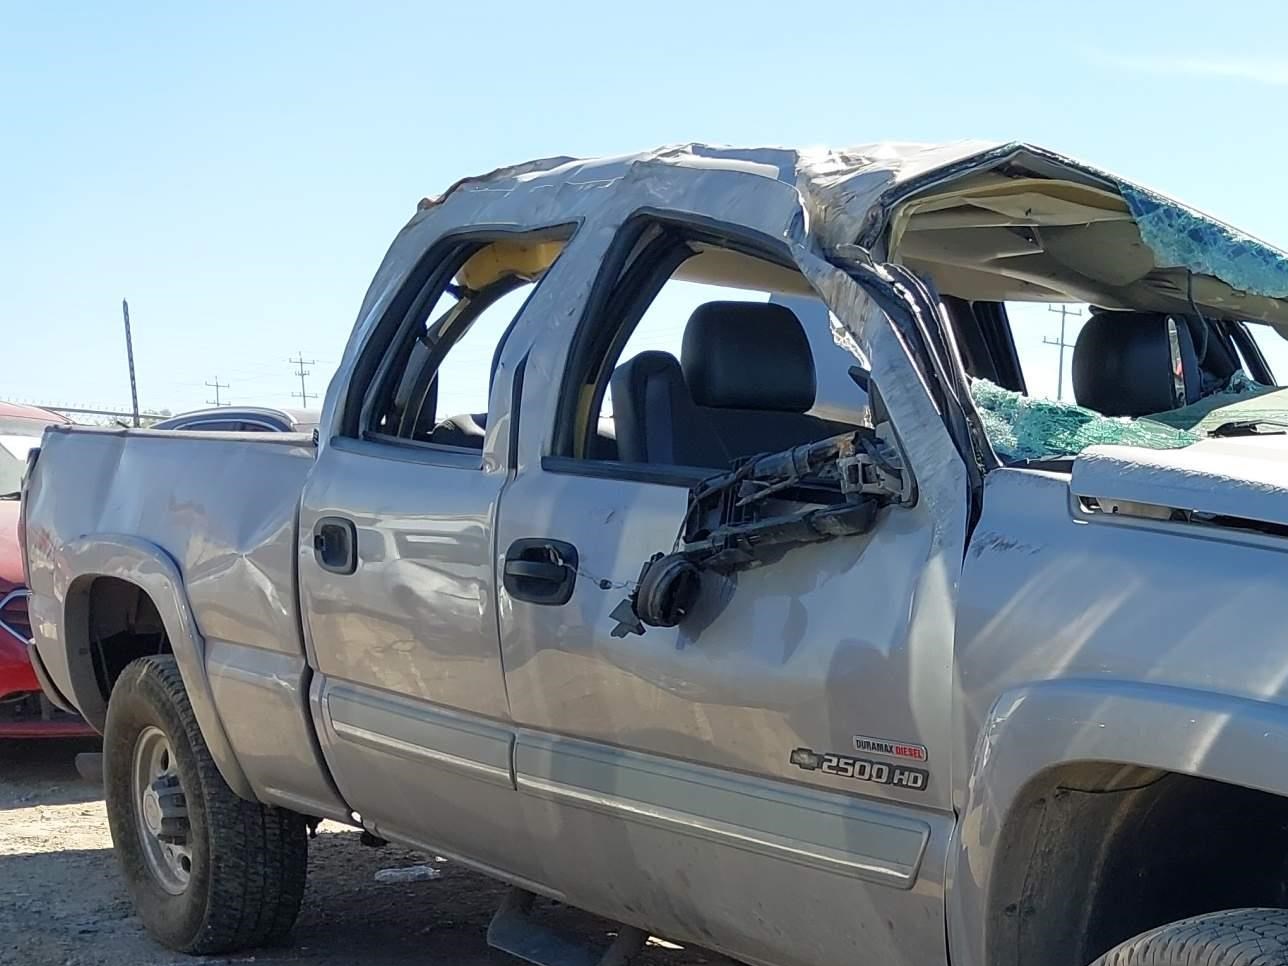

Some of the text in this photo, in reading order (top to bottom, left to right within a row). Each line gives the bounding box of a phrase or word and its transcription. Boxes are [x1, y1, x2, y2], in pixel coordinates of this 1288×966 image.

[856, 739, 924, 759] DURAMAX DIESEL
[822, 755, 923, 788] 2500 HD
